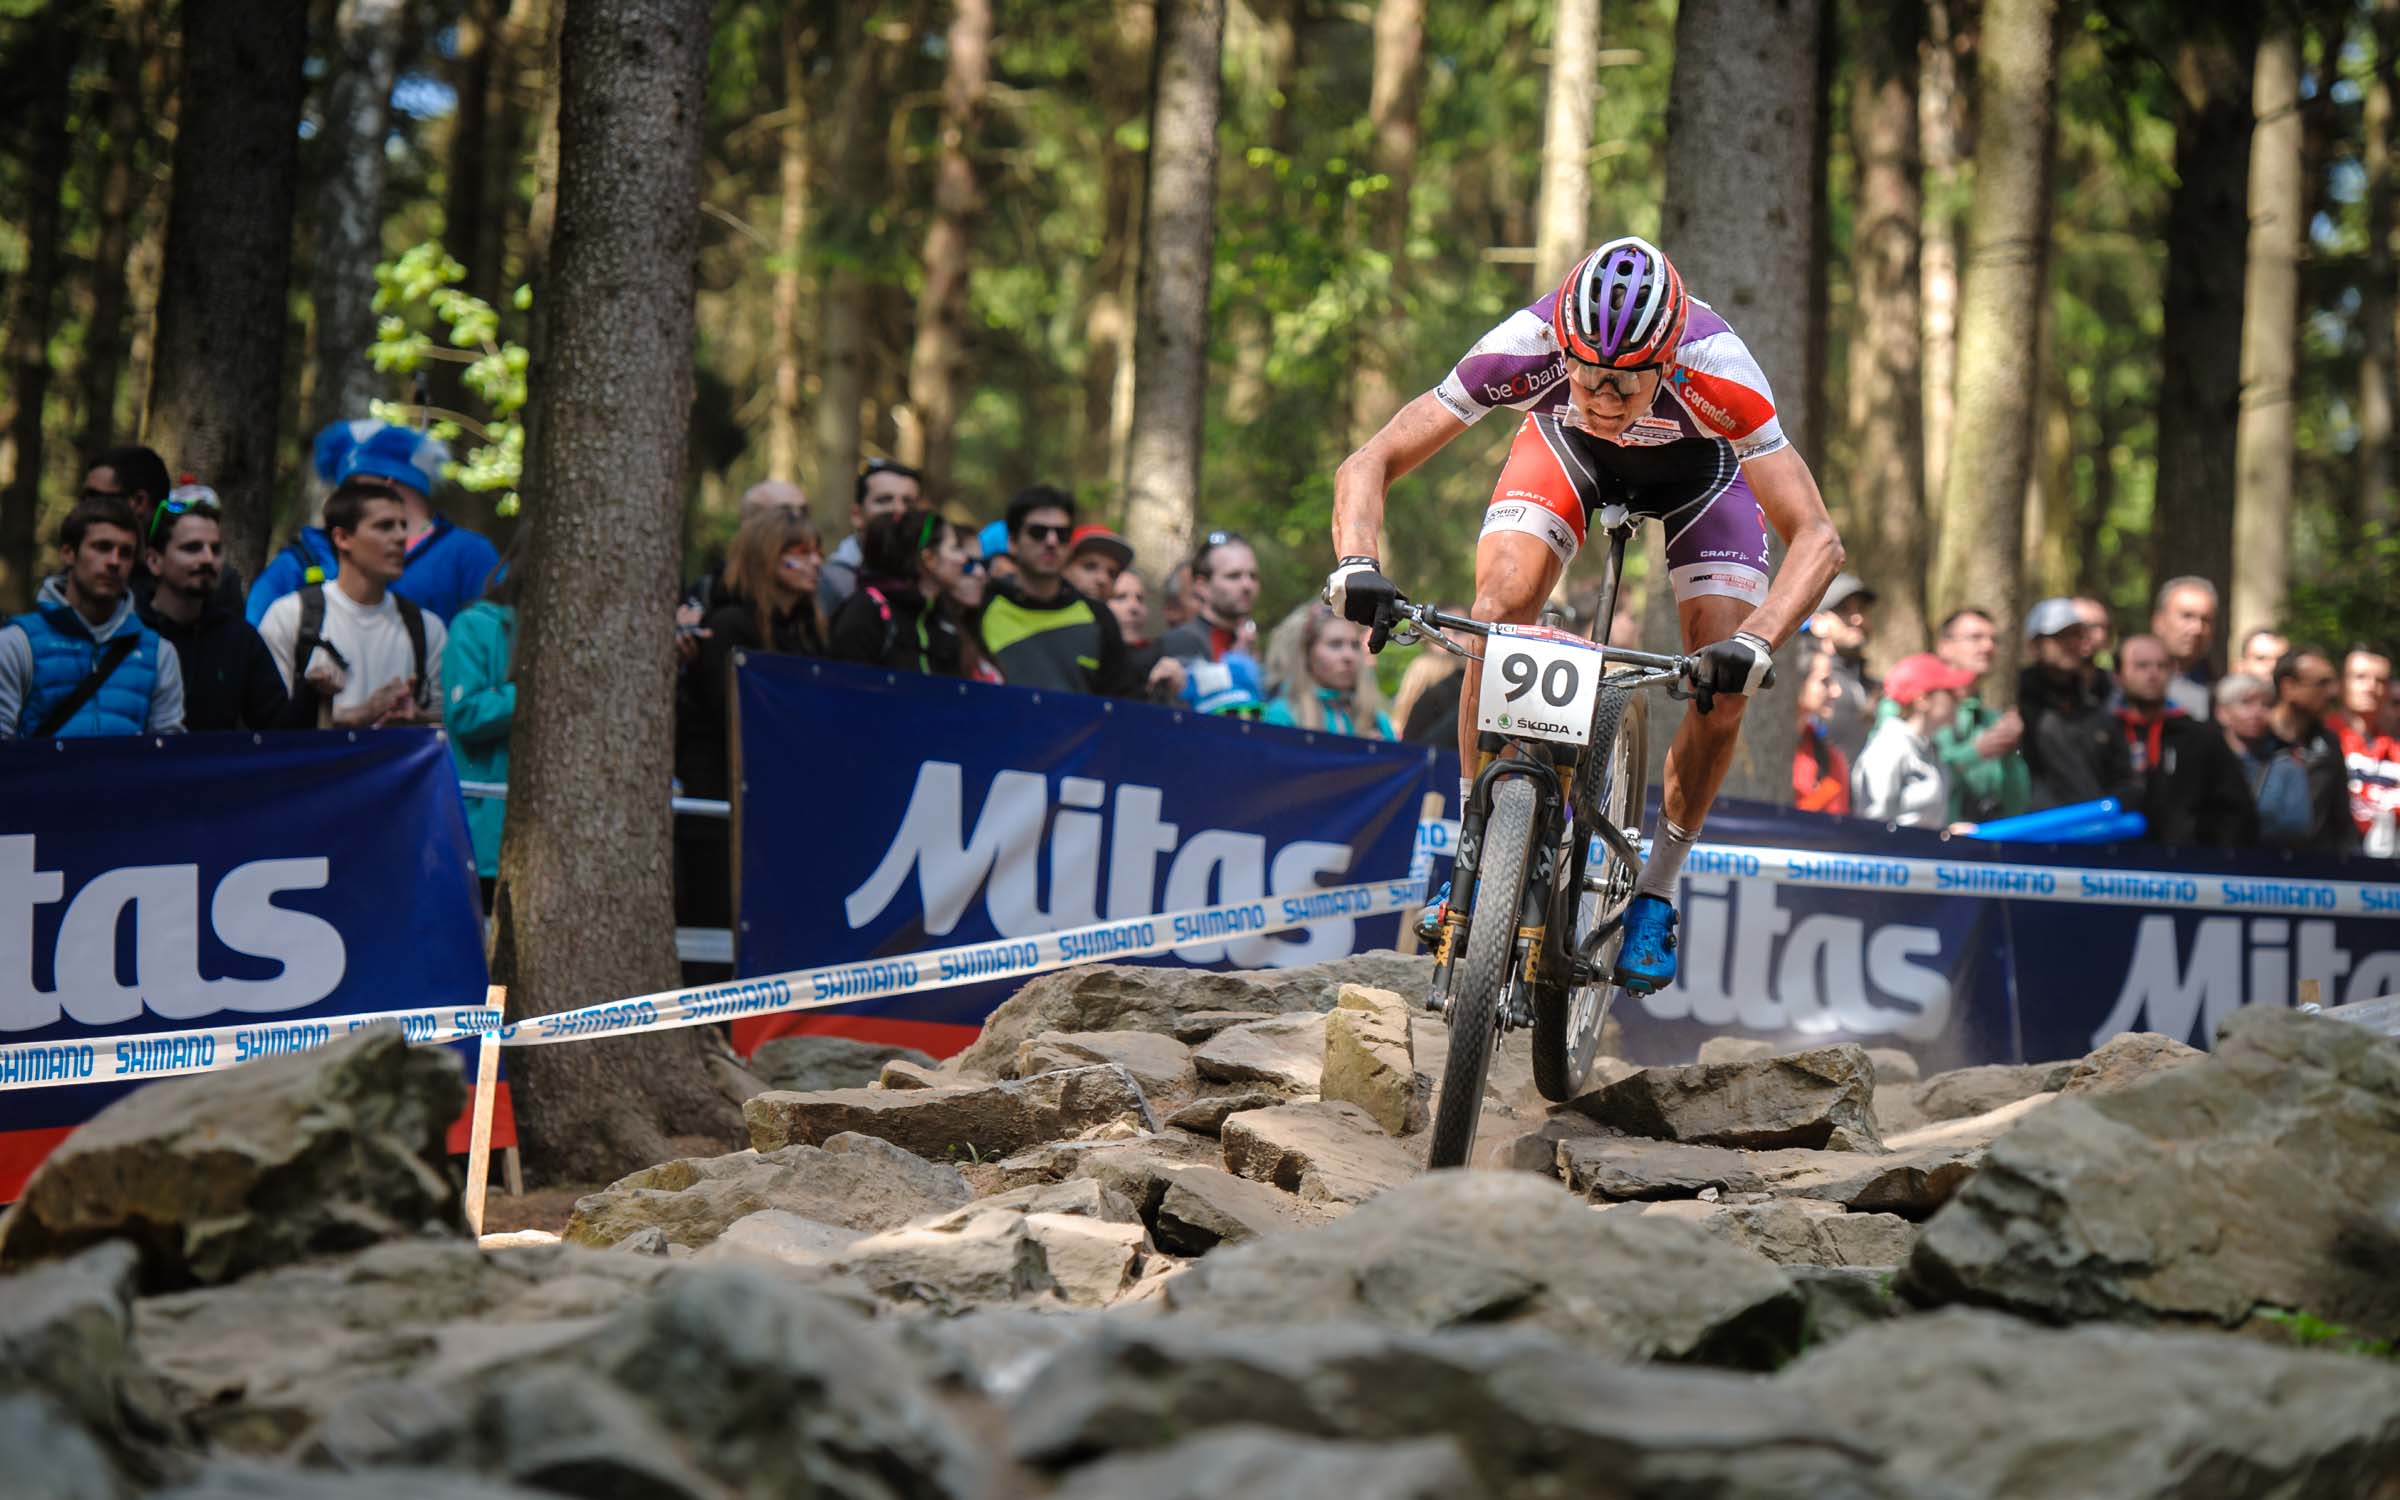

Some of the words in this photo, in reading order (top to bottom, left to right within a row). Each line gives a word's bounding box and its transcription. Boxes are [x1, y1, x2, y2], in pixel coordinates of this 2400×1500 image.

[1684, 385, 1736, 431] corendon
[1506, 490, 1546, 502] CRAFT
[1502, 652, 1579, 708] 90
[1517, 717, 1570, 735] ŠKODA
[845, 760, 1355, 969] Mitas
[1787, 858, 1910, 887] SHIMANO
[1936, 866, 2056, 895] SHIMANO
[2081, 874, 2197, 902] SHIMANO
[2222, 881, 2337, 910] SHIMANO
[537, 1000, 658, 1038] SHIMANO
[678, 979, 791, 1019] SHIMANO
[812, 960, 919, 1000] SHIMANO
[939, 939, 1039, 979] SHIMANO
[1059, 922, 1155, 961] SHIMANO
[1174, 904, 1265, 942] SHIMANO
[1283, 887, 1371, 923] SHIMANO
[115, 1034, 215, 1074] SHIMANO
[235, 1023, 329, 1063] SHIMANO
